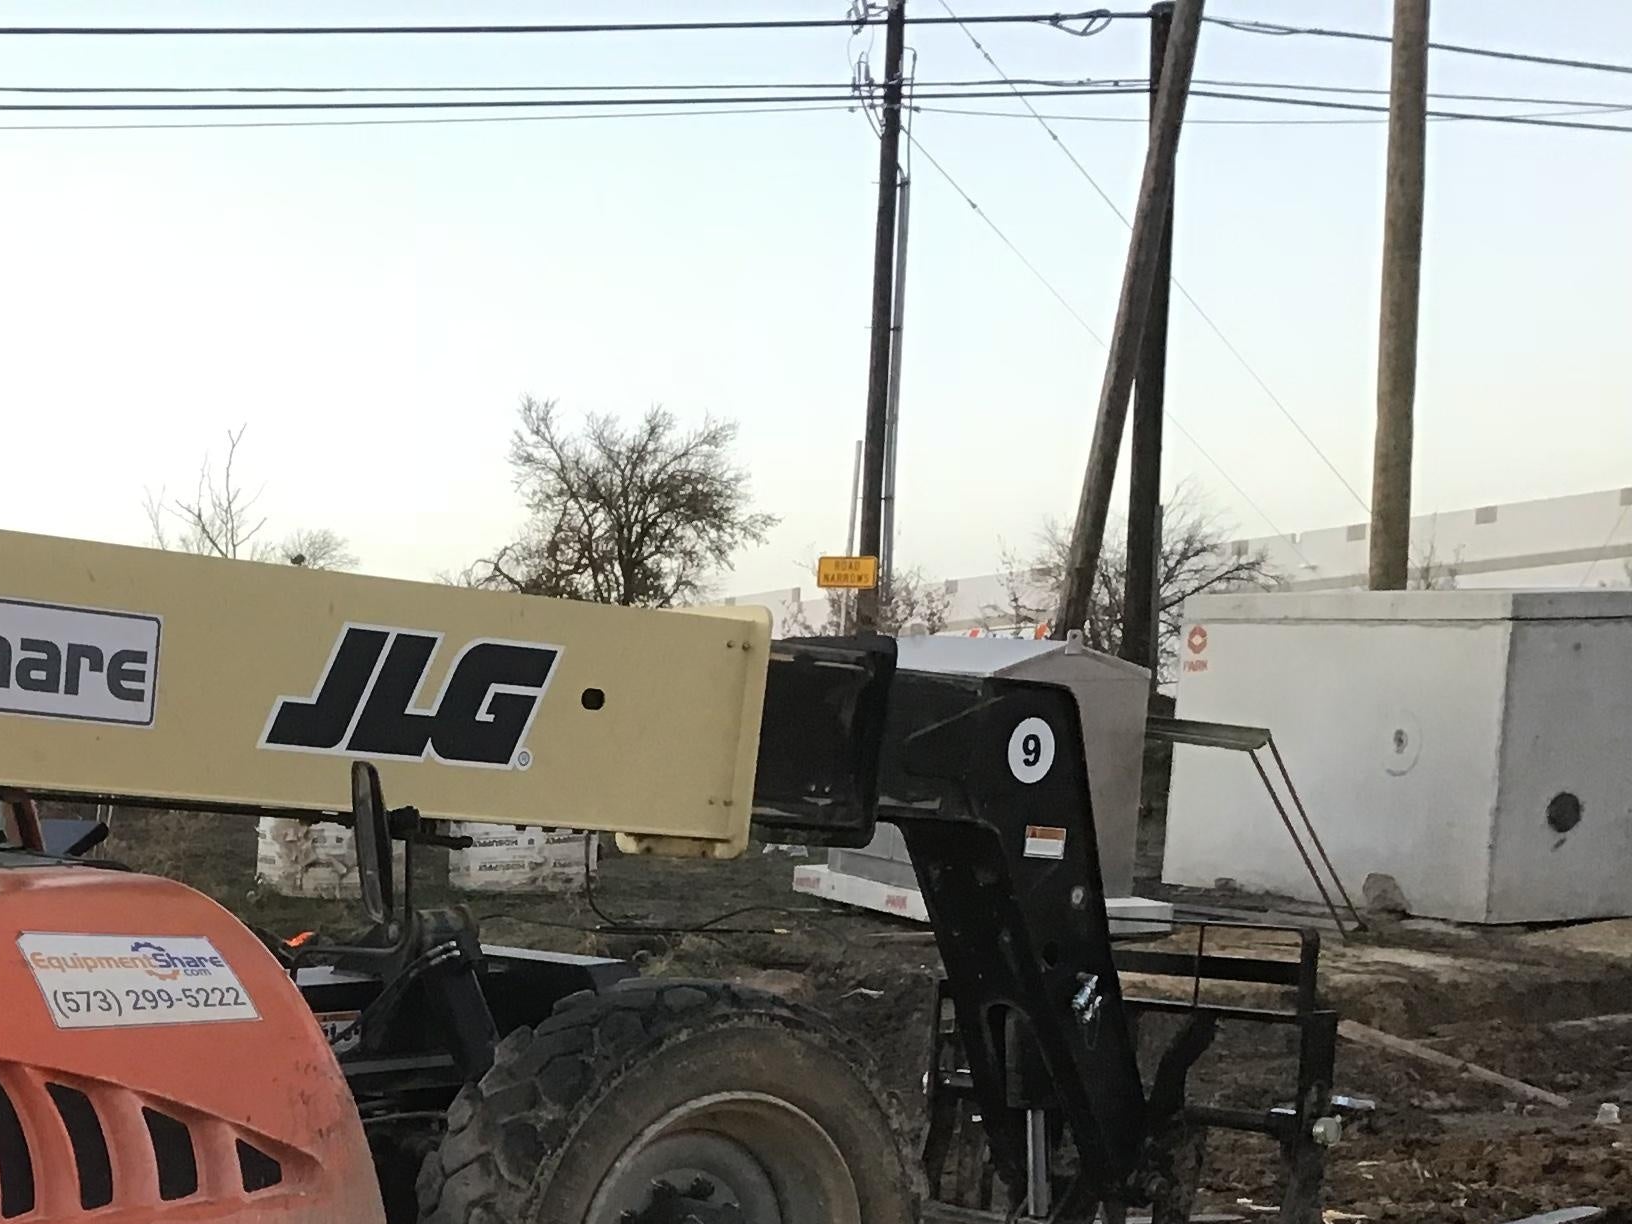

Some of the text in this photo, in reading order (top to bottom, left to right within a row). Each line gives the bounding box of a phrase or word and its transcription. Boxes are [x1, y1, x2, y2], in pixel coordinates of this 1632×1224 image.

[823, 572, 870, 583] NARROWS
[834, 560, 861, 571] ROAD
[263, 627, 560, 765] JLG
[1022, 733, 1042, 767] 9
[29, 951, 226, 973] EquipmentShare
[53, 986, 246, 1019] (573) 299-5222
